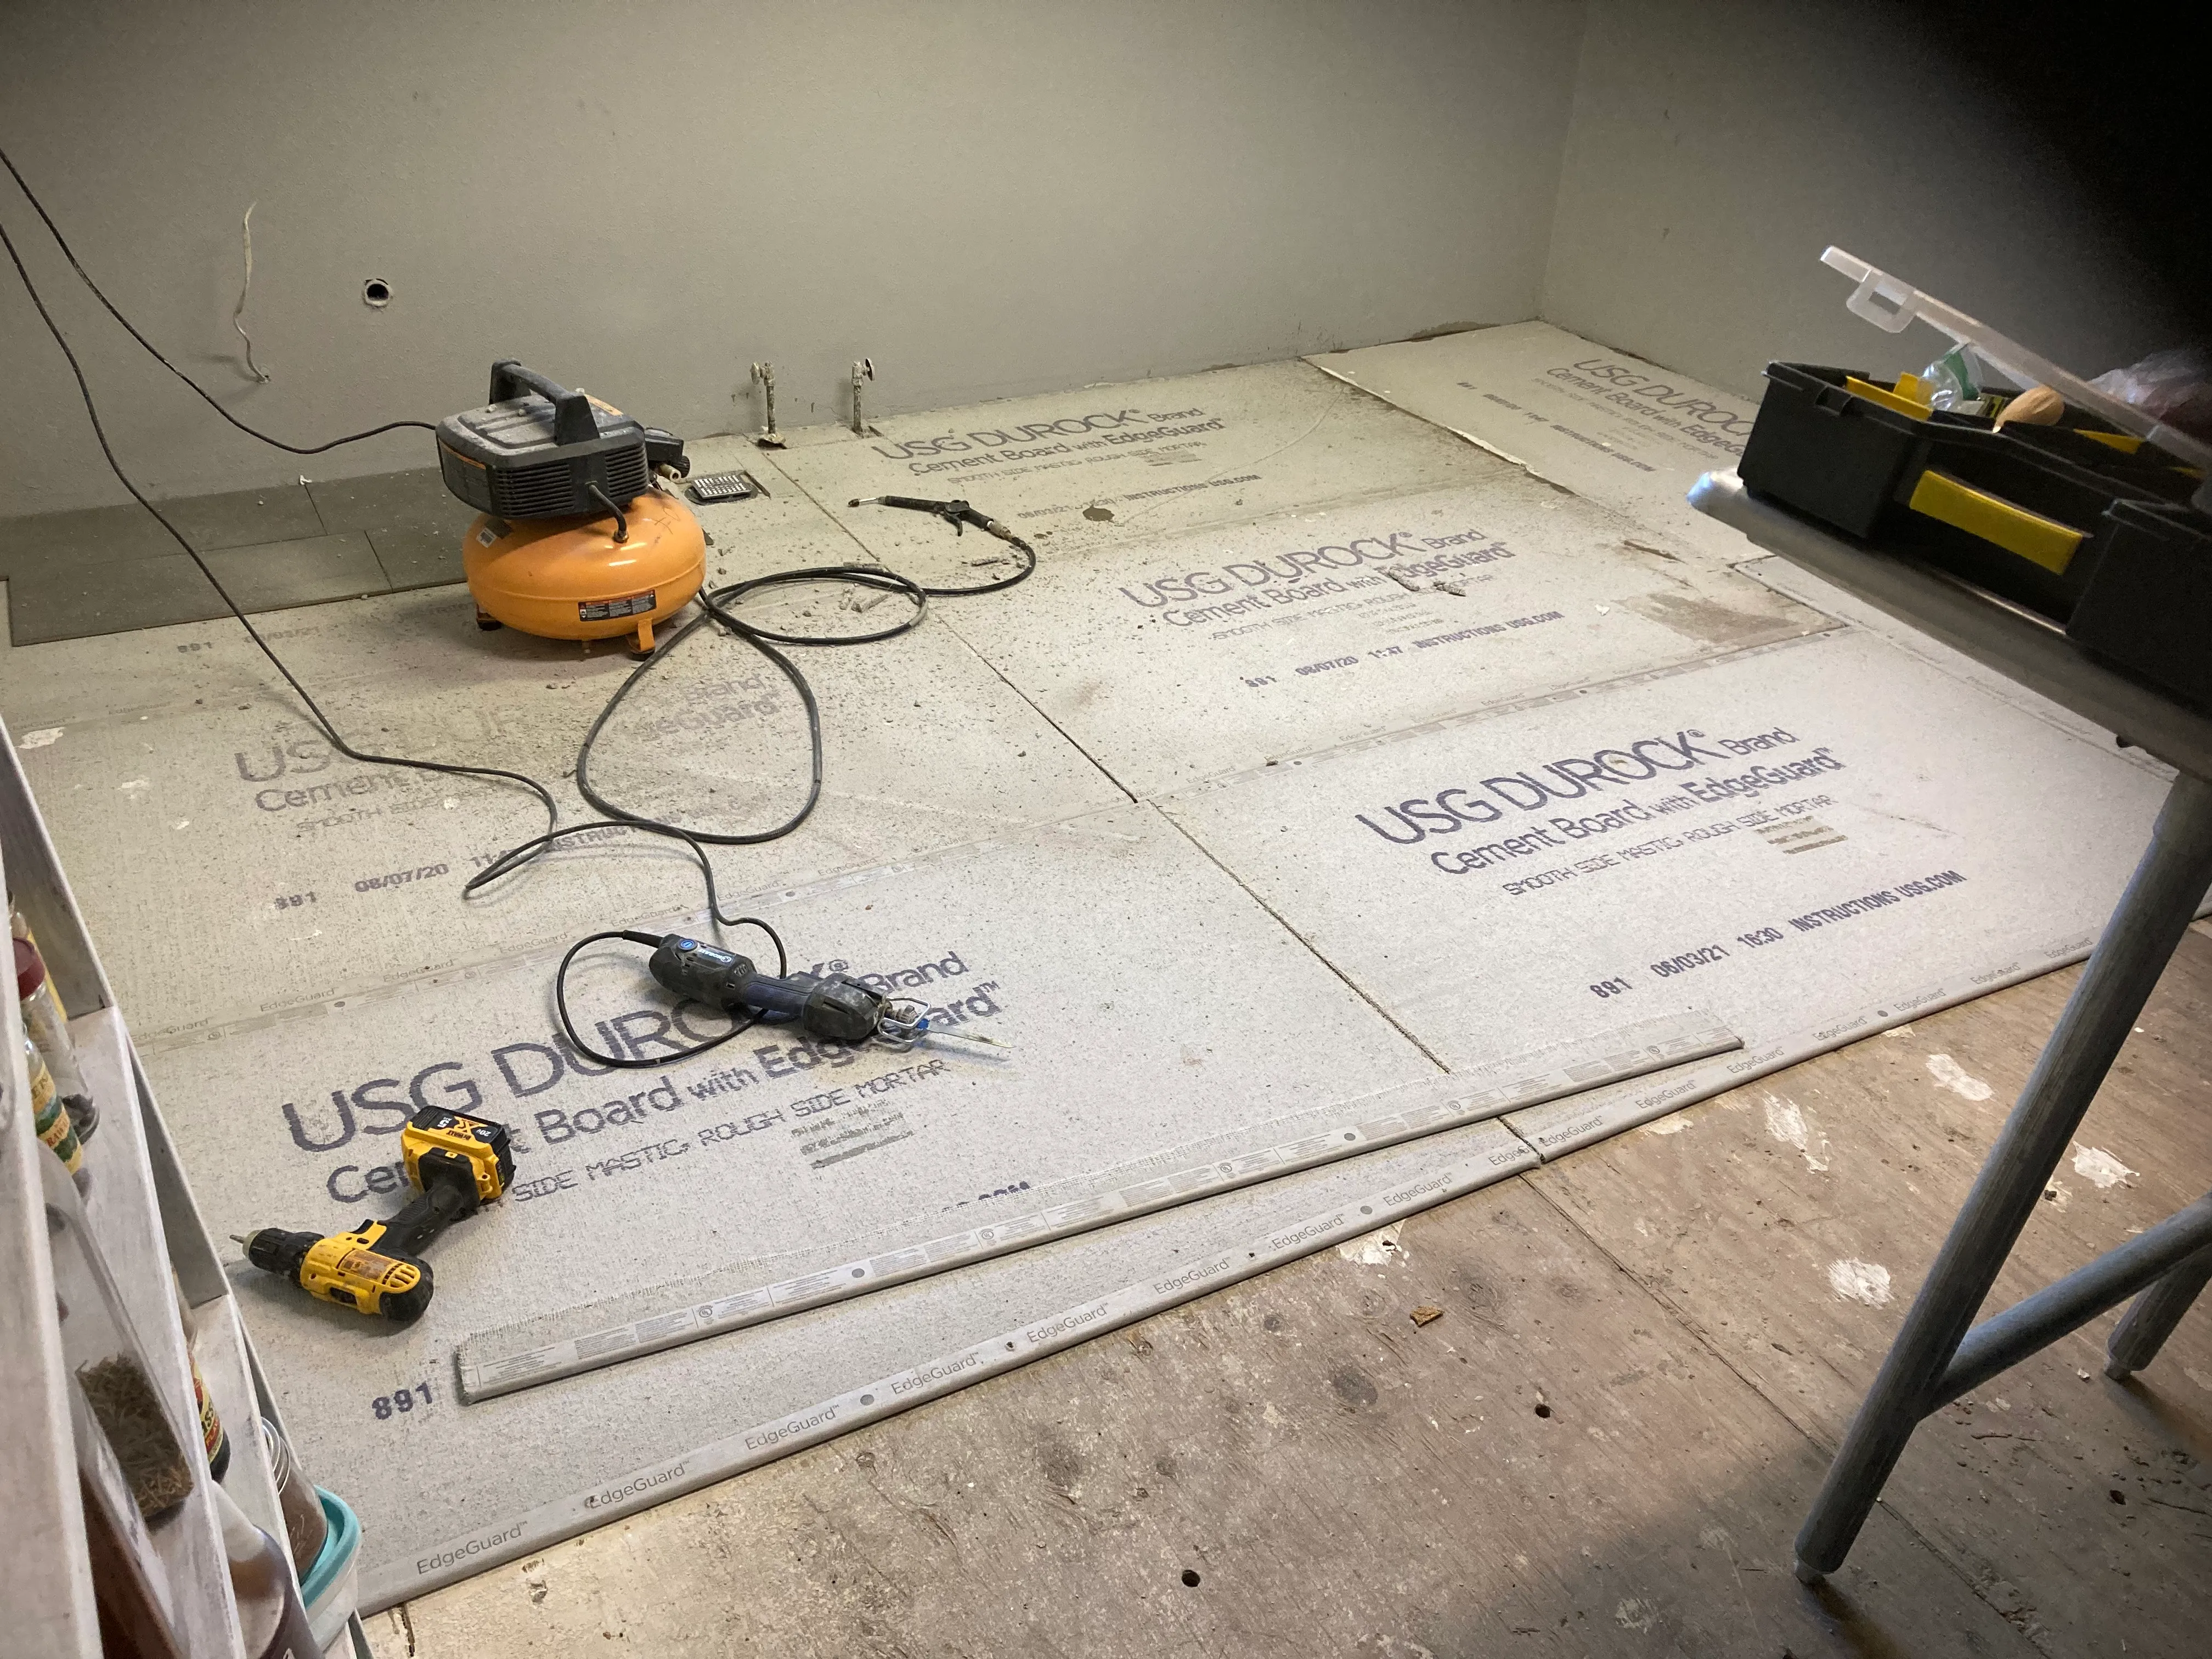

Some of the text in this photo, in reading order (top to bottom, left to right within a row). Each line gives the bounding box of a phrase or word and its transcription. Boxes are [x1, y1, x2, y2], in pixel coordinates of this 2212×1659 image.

[872, 432, 972, 460] USG
[1151, 407, 1205, 422] Brand
[1547, 367, 1613, 395] Cement
[1605, 391, 1666, 416] Board
[1680, 423, 1746, 457] EdgeG
[1573, 358, 1650, 387] USG
[1633, 384, 1756, 437] DUROC
[908, 451, 996, 476] Cement
[1001, 441, 1072, 462] Board
[1072, 437, 1109, 451] with
[1118, 570, 1235, 611] USG
[1421, 528, 1488, 551] Brand
[1163, 594, 1272, 628] Cement
[1268, 577, 1347, 606] Board
[1345, 572, 1385, 590] with
[1412, 623, 1506, 649] INSTRUCTIONS
[1505, 611, 1565, 629] USG.COM
[1355, 787, 1503, 848] USG
[1718, 725, 1801, 758] Brand
[1430, 827, 1565, 877] Cement
[1563, 799, 1651, 843] Board
[1649, 791, 1702, 820] with
[1502, 867, 1575, 897] SMOOTH
[1573, 854, 1621, 874] SIDE
[1686, 821, 1737, 843] ROUGH
[1736, 809, 1780, 828] SIDE
[1776, 794, 1839, 818] MORTAR
[354, 863, 450, 893] 08/07/20
[1590, 977, 1633, 1000] 891
[1650, 944, 1731, 978] 06/03/21
[1788, 890, 1901, 933] INSTRUCTIONS
[1897, 870, 1968, 898] USG.COM
[281, 1060, 483, 1153] USG
[859, 950, 970, 992] Brand
[512, 1170, 579, 1204] SIDE
[698, 1108, 786, 1148] ROUGH
[790, 1088, 851, 1118] SIDE
[856, 1059, 951, 1100] MORTAR
[534, 1074, 682, 1146] Board
[686, 1066, 761, 1102] with
[371, 1381, 434, 1420] 891
